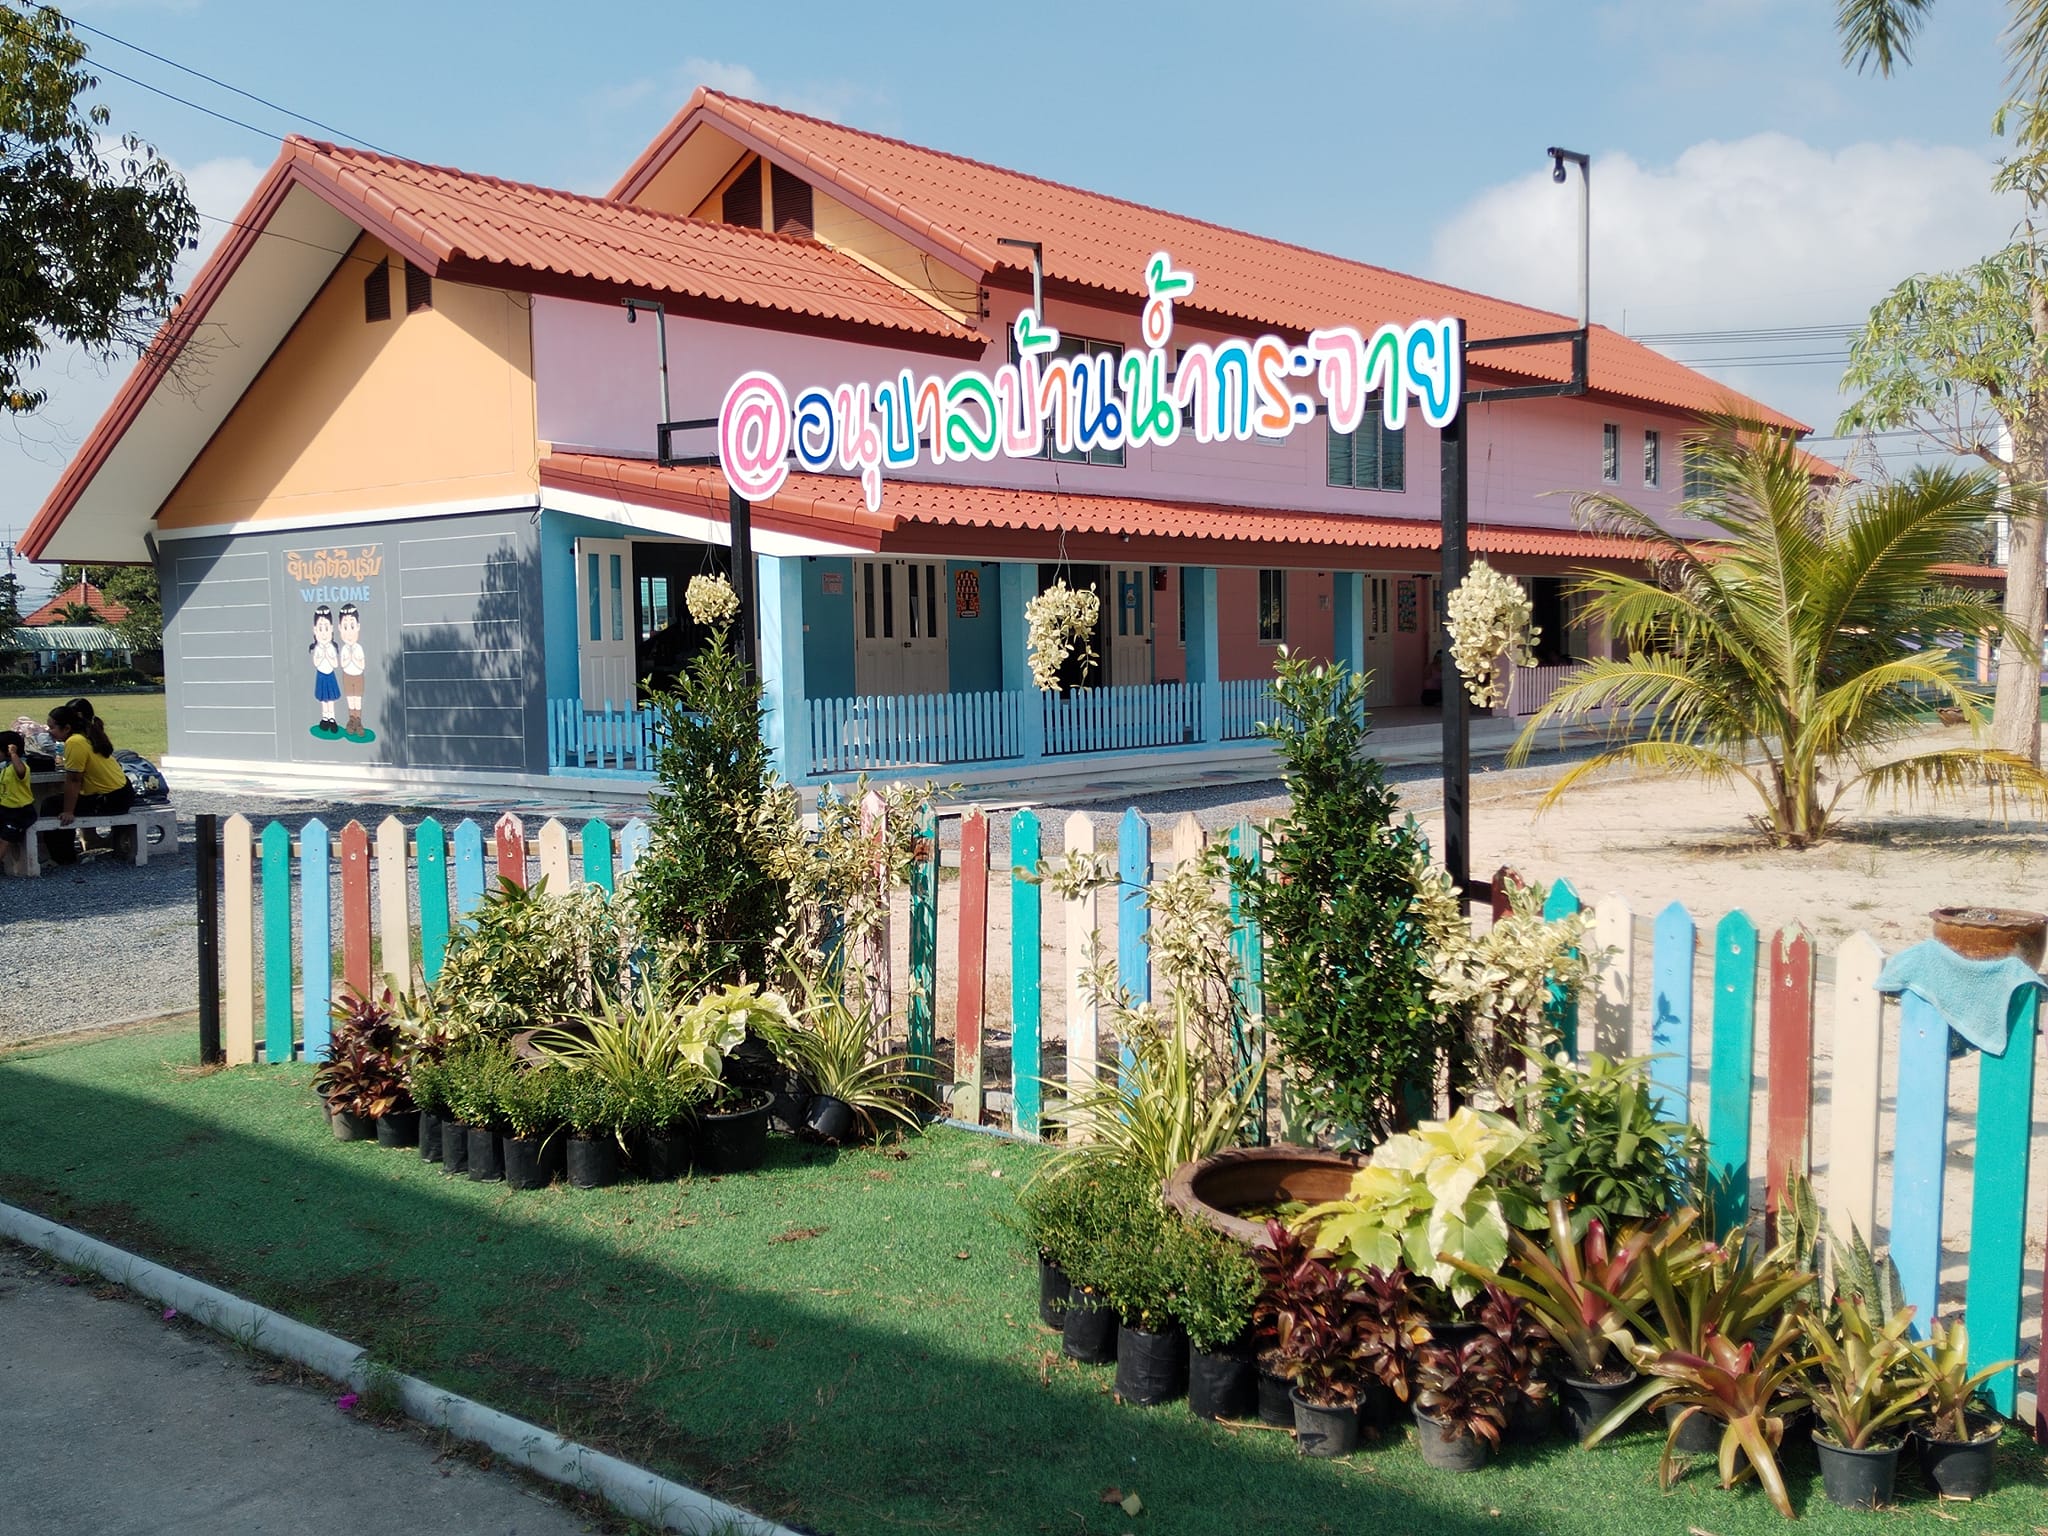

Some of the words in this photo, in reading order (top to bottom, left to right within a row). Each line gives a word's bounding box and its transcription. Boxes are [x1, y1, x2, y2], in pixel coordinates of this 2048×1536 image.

[287, 545, 382, 585] ยินดีต้อนรับ
[301, 586, 370, 602] WELCOME
